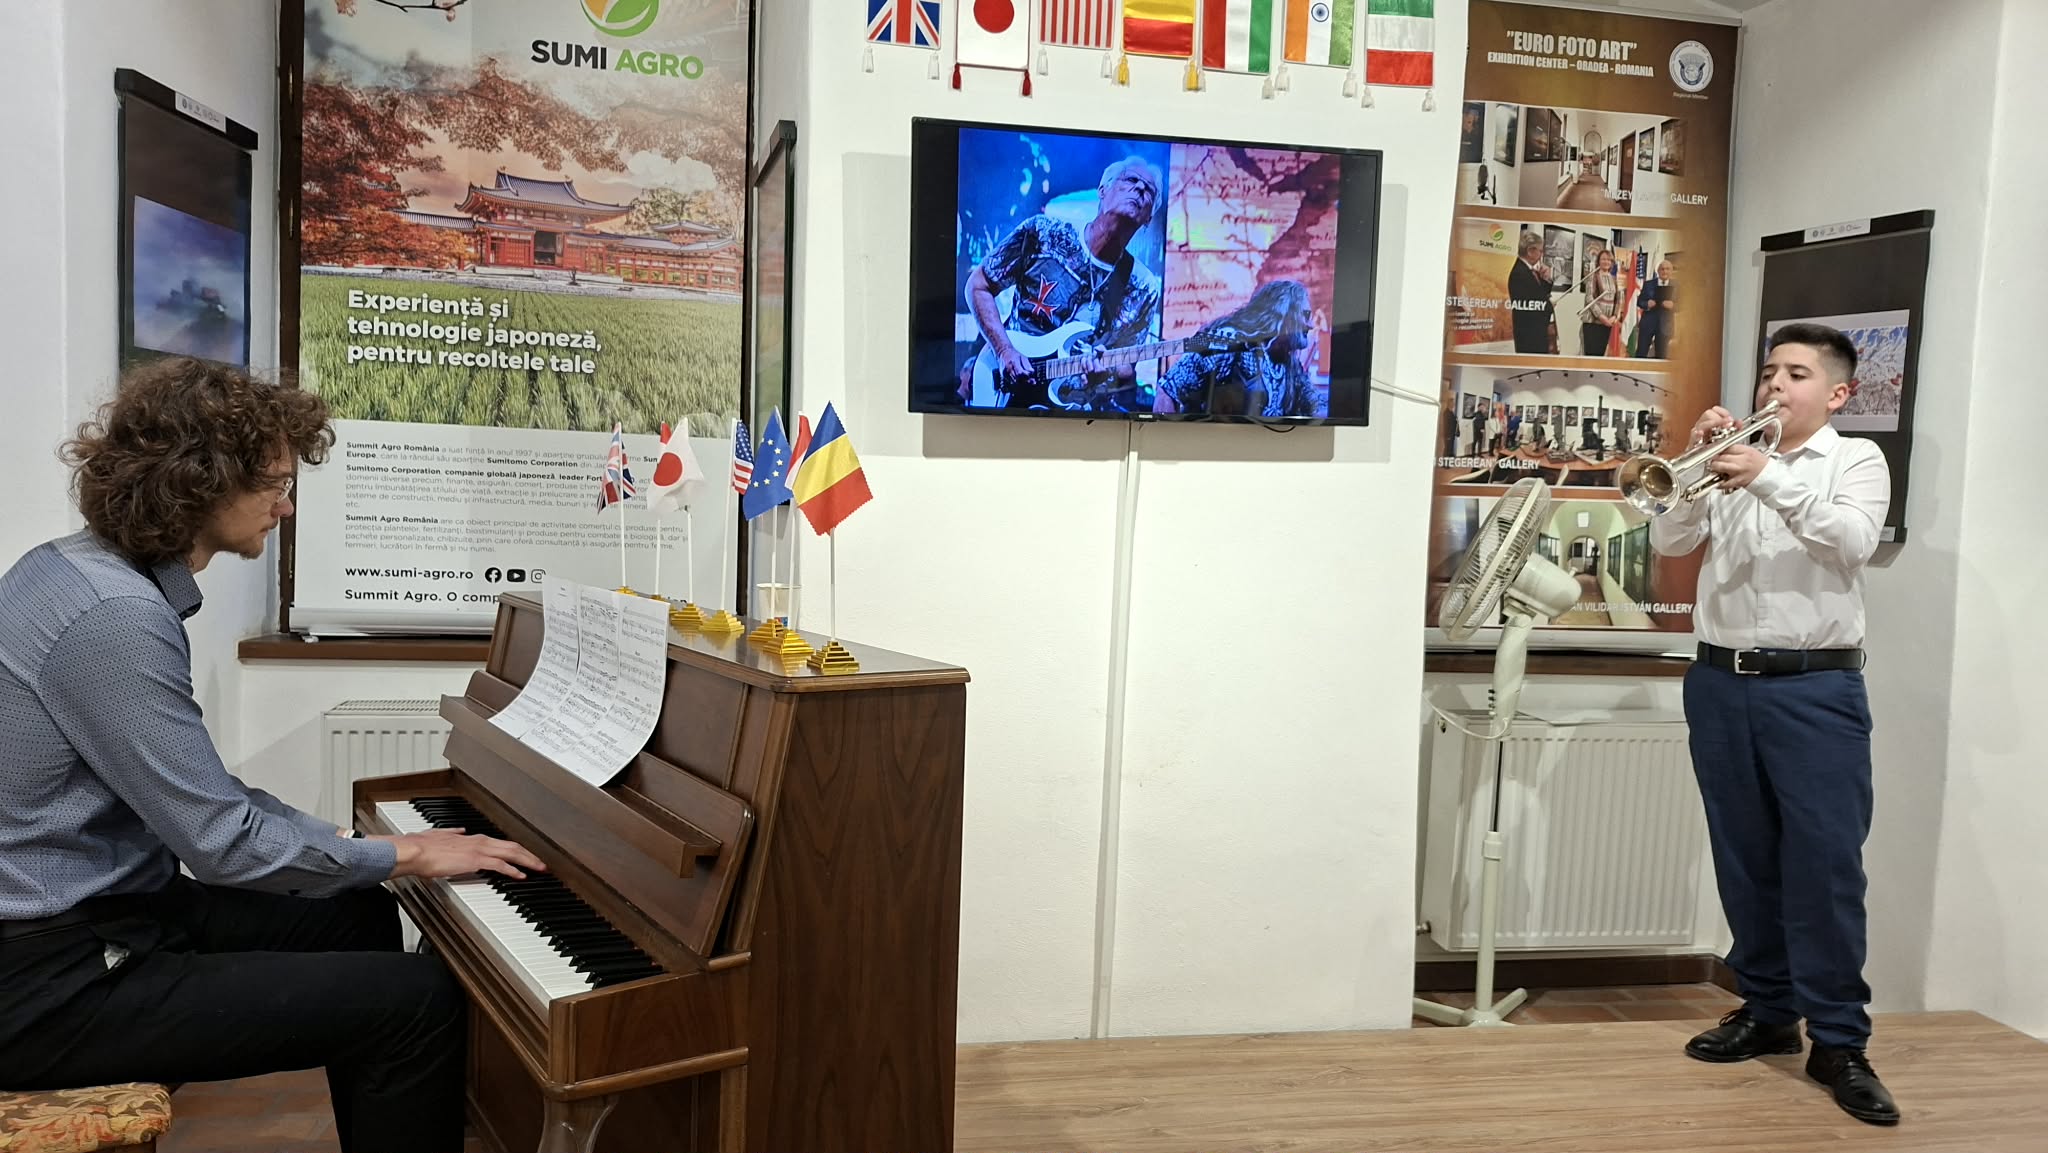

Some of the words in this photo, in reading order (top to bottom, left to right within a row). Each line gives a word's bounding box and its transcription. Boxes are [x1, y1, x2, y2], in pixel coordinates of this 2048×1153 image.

[1557, 35, 1597, 58] FOTO
[531, 39, 608, 70] SUMI
[614, 49, 705, 80] AGRO
[1487, 51, 1535, 66] EXHIBITION
[1536, 56, 1569, 69] CENTER
[1576, 59, 1609, 73] ORADEA
[1615, 63, 1654, 77] ROMANIA
[1670, 192, 1709, 206] GALLERY
[348, 289, 484, 321] Experiență
[489, 298, 509, 322] și
[1504, 299, 1547, 312] GALLERY
[348, 315, 482, 345] tehnologie
[485, 322, 602, 352] japoneză,
[348, 344, 432, 364] pentru
[438, 348, 545, 372] recoltele
[550, 354, 596, 374] tale
[346, 441, 379, 450] Summit
[381, 443, 402, 452] Agro
[404, 444, 440, 452] România
[487, 457, 528, 466] Sumitomo
[530, 459, 578, 468] Corporation
[1498, 459, 1541, 470] GALLERY
[346, 464, 389, 473] Sumitomo
[445, 469, 485, 478] companie
[487, 471, 517, 480] globală
[559, 473, 584, 481] leader
[345, 514, 378, 522] Summit
[380, 515, 401, 523] Agro
[402, 515, 439, 524] România
[345, 567, 474, 581] www.sumi-agro.ro
[345, 589, 399, 601] Summit
[403, 591, 442, 603] Agro.
[447, 592, 458, 601] O
[1652, 602, 1694, 614] GALLERY
